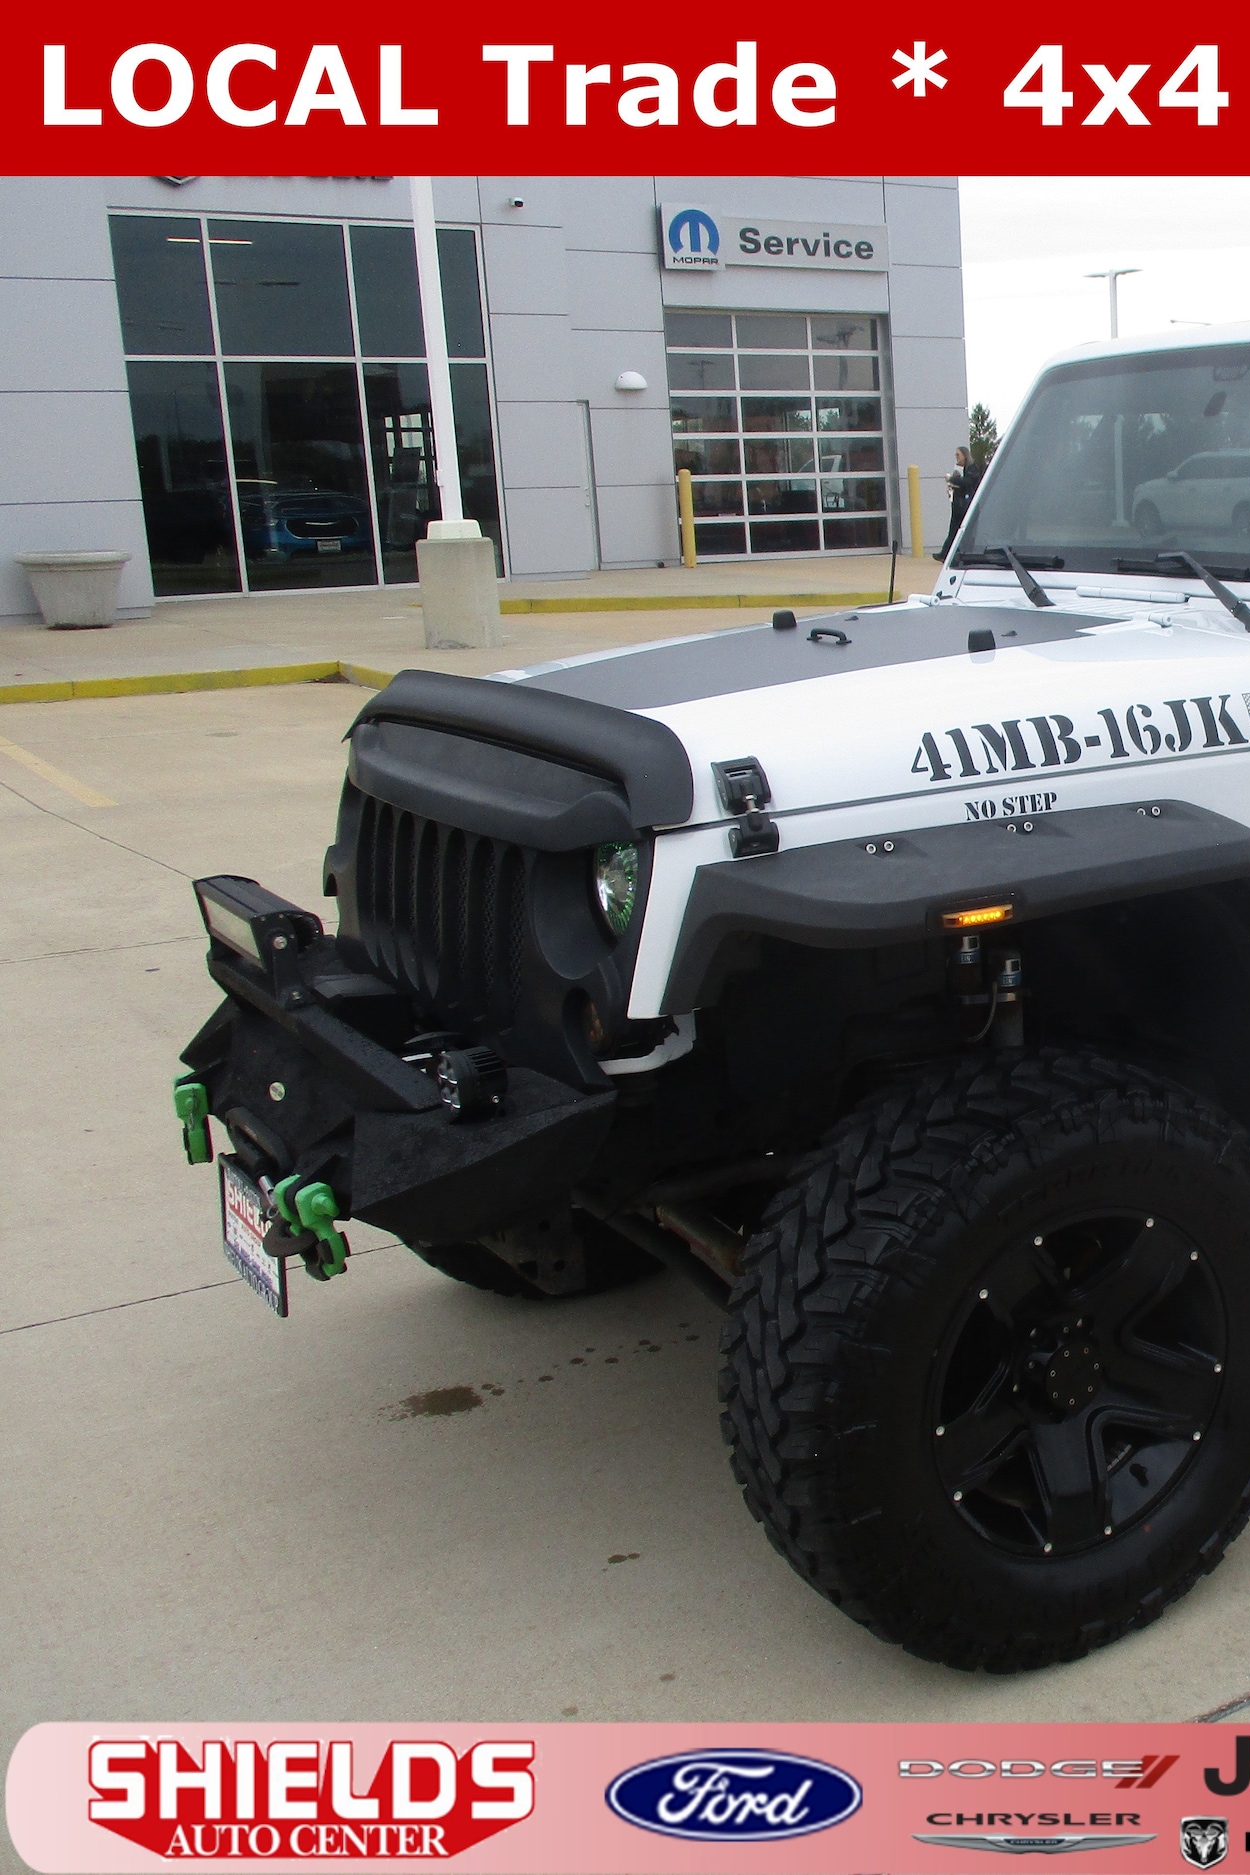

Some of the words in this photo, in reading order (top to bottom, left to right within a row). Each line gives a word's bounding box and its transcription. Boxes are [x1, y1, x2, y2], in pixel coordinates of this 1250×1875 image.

[738, 226, 874, 260] Service
[672, 256, 719, 265] MOPAR
[910, 694, 1249, 782] 41MB-16JK
[964, 800, 996, 821] NO
[1001, 791, 1058, 817] STEP
